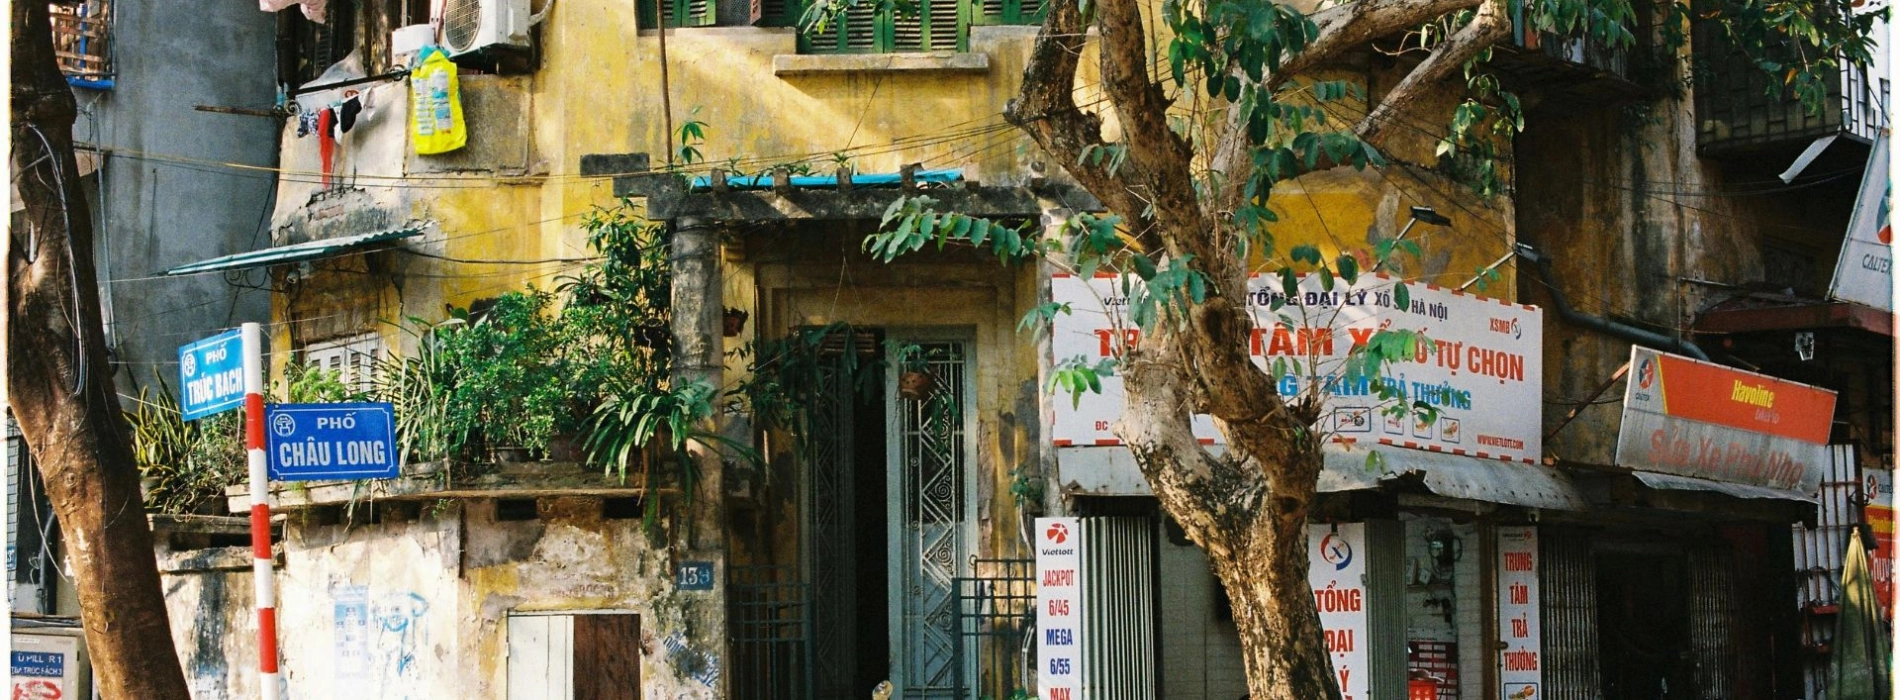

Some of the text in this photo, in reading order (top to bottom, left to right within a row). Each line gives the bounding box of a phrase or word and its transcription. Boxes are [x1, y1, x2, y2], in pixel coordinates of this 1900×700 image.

[1305, 291, 1338, 309] ĐẠI
[1345, 289, 1367, 306] LÝ
[1375, 289, 1390, 308] XỔ
[1411, 298, 1426, 316] HÀ
[1429, 303, 1448, 322] NỘI
[1490, 317, 1510, 334] XSMB
[205, 341, 227, 365] PHỐ
[1250, 321, 1333, 356] TÂM
[1434, 339, 1463, 376] TỰ
[1467, 346, 1524, 384] CHỌN
[187, 367, 243, 405] TRÚC BẠCH
[1731, 379, 1774, 408] Havoline
[317, 412, 356, 429] PHỐ
[279, 436, 386, 467] CHÂU LONG
[1042, 548, 1073, 556] Vietlott
[1504, 552, 1533, 571] TRUNG
[1043, 569, 1074, 587] JACKPOT
[1315, 580, 1362, 613] TỔNG
[1509, 581, 1529, 605] TÂM
[1048, 600, 1070, 617] 6/45
[1046, 628, 1073, 646] MEGA
[1511, 612, 1529, 638] TRẢ
[1325, 629, 1354, 658] ĐẠI
[1050, 658, 1071, 675] 6/55
[1504, 647, 1538, 672] THƯỞNG
[1339, 664, 1350, 692] Ý
[1050, 688, 1071, 700] MAX
